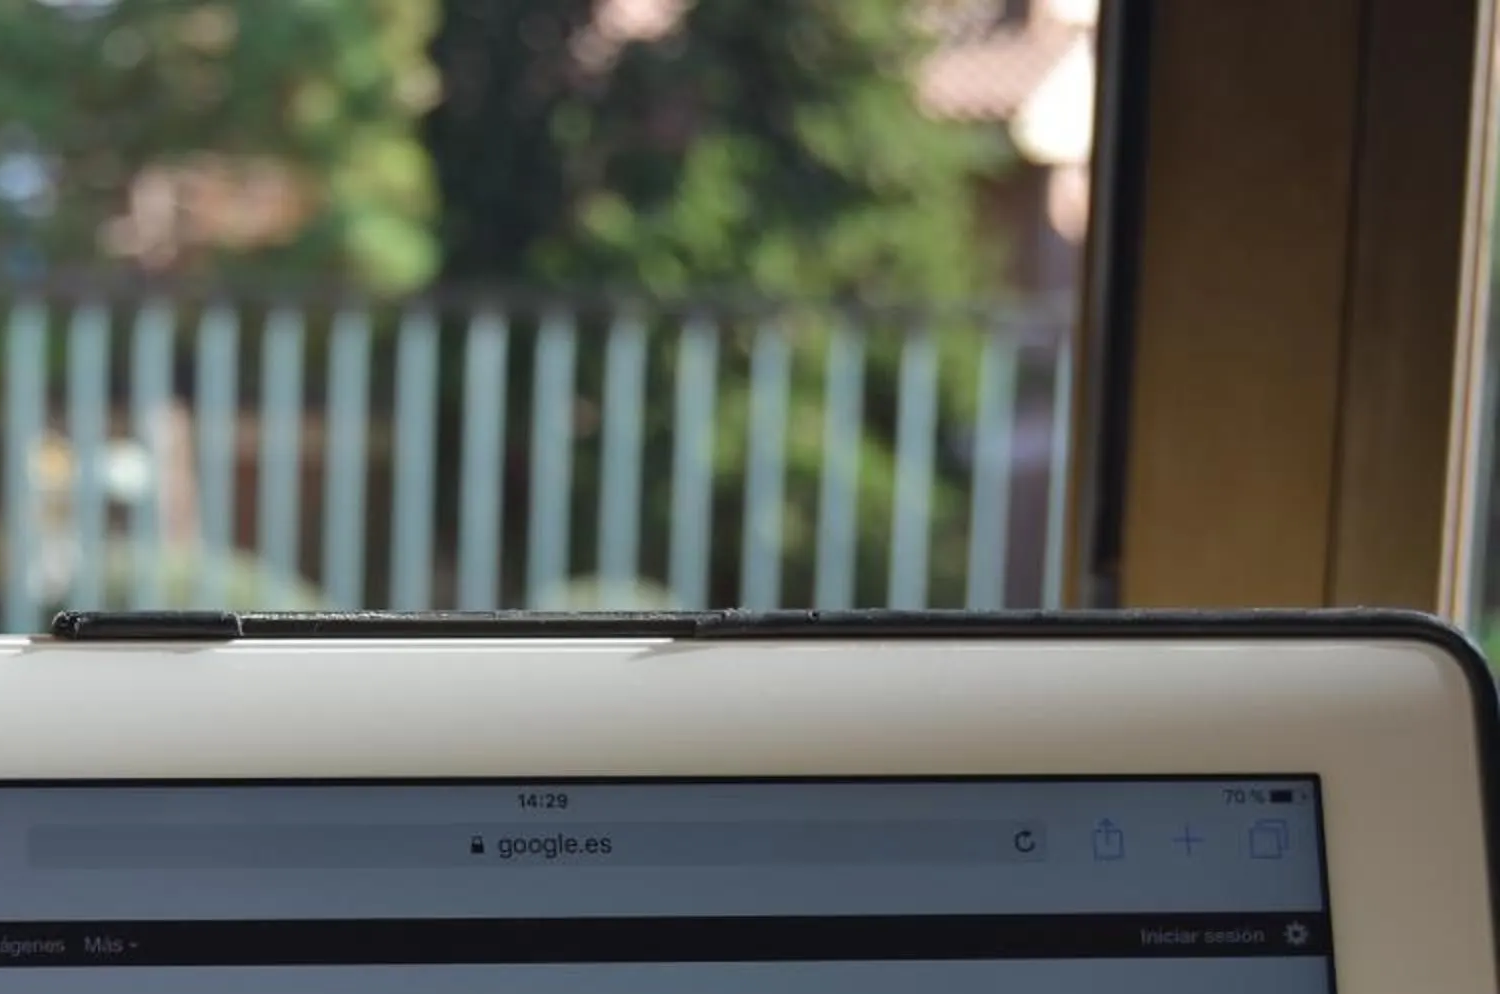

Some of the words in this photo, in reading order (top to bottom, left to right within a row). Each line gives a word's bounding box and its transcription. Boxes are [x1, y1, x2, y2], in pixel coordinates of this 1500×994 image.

[517, 793, 569, 809] 14:29
[1223, 789, 1246, 805] 70
[498, 832, 612, 859] google.es
[84, 934, 123, 953] Más
[1140, 927, 1198, 945] Iniciar
